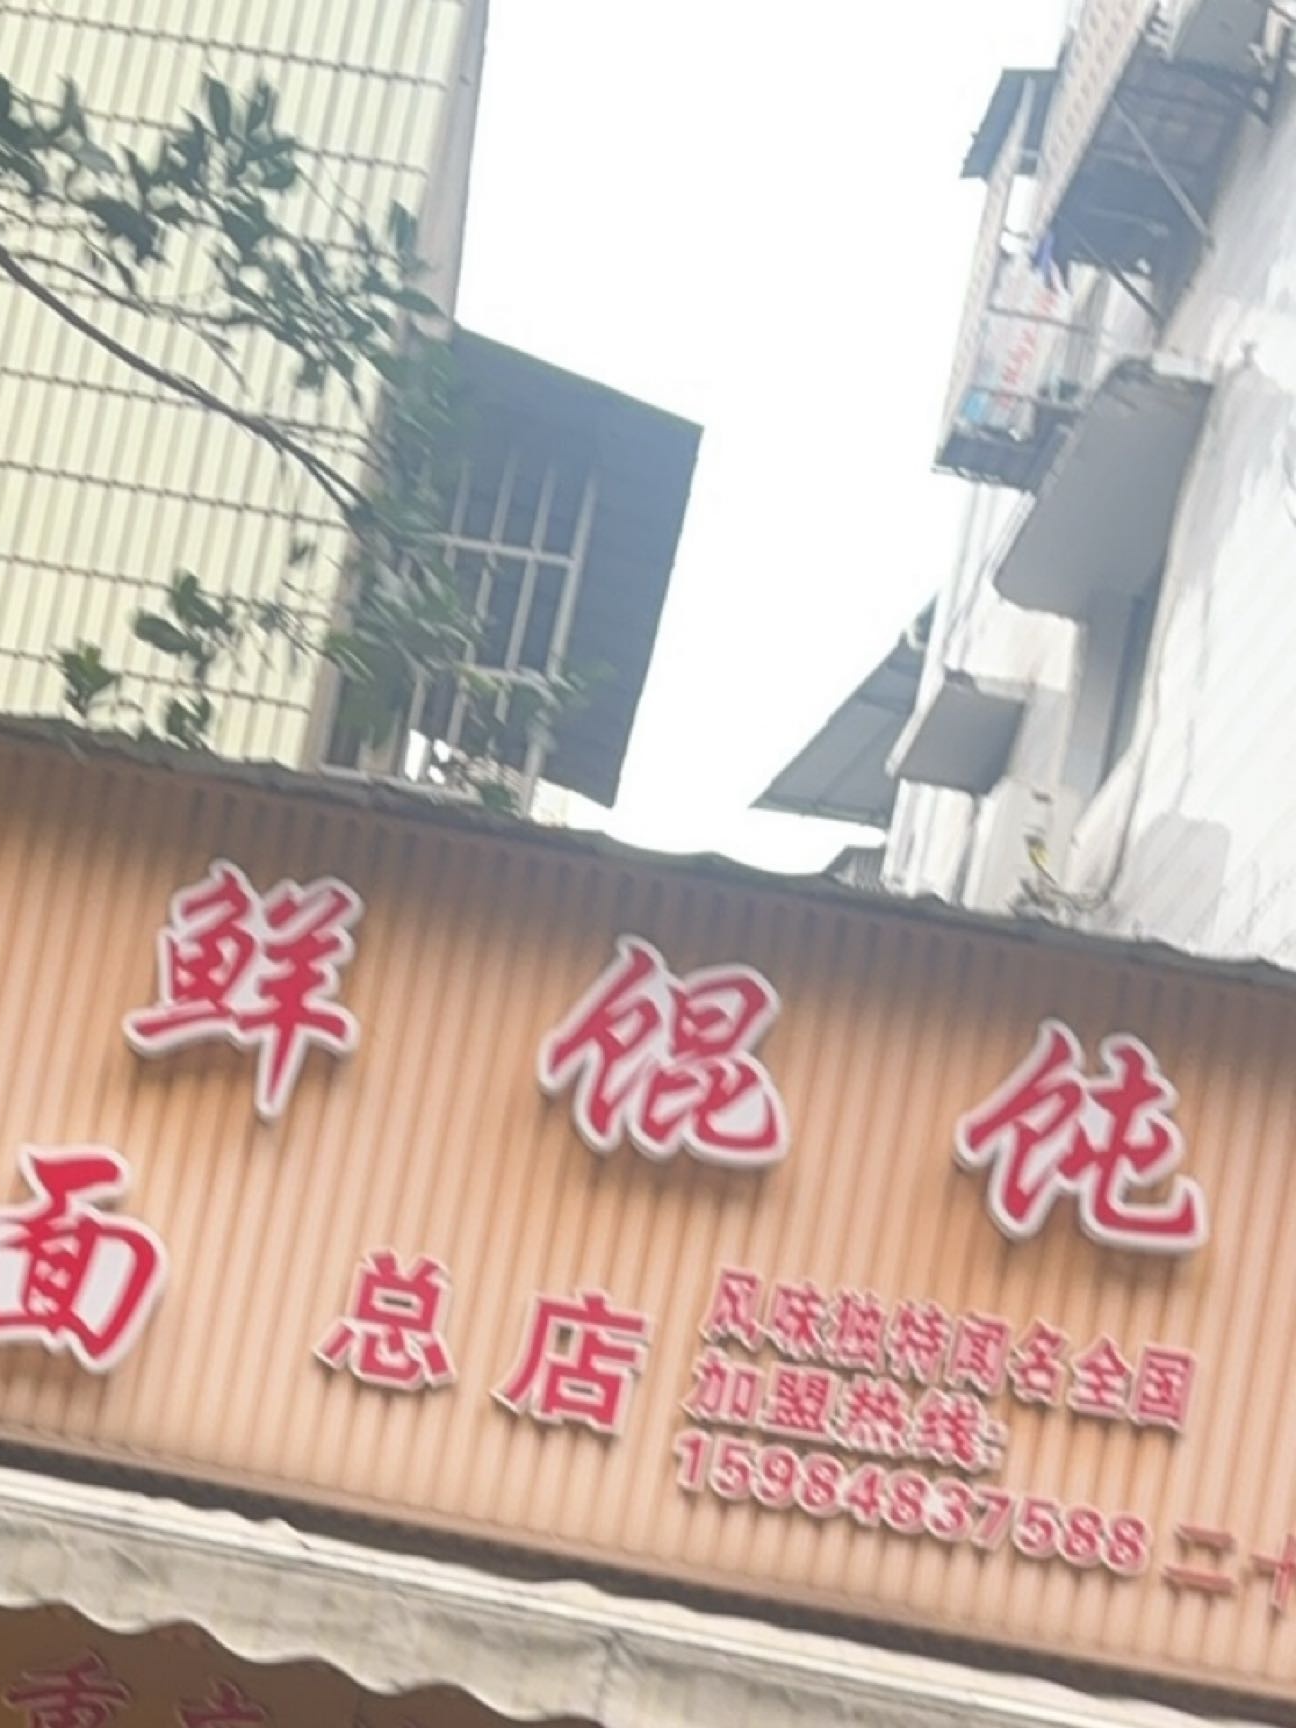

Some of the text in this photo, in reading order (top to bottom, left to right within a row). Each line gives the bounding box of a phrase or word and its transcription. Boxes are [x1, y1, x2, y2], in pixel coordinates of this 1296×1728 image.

[315, 1248, 650, 1437] 总店
[700, 1267, 1197, 1434] 风味独特闻名全国
[675, 1429, 1152, 1577] 15984837588
